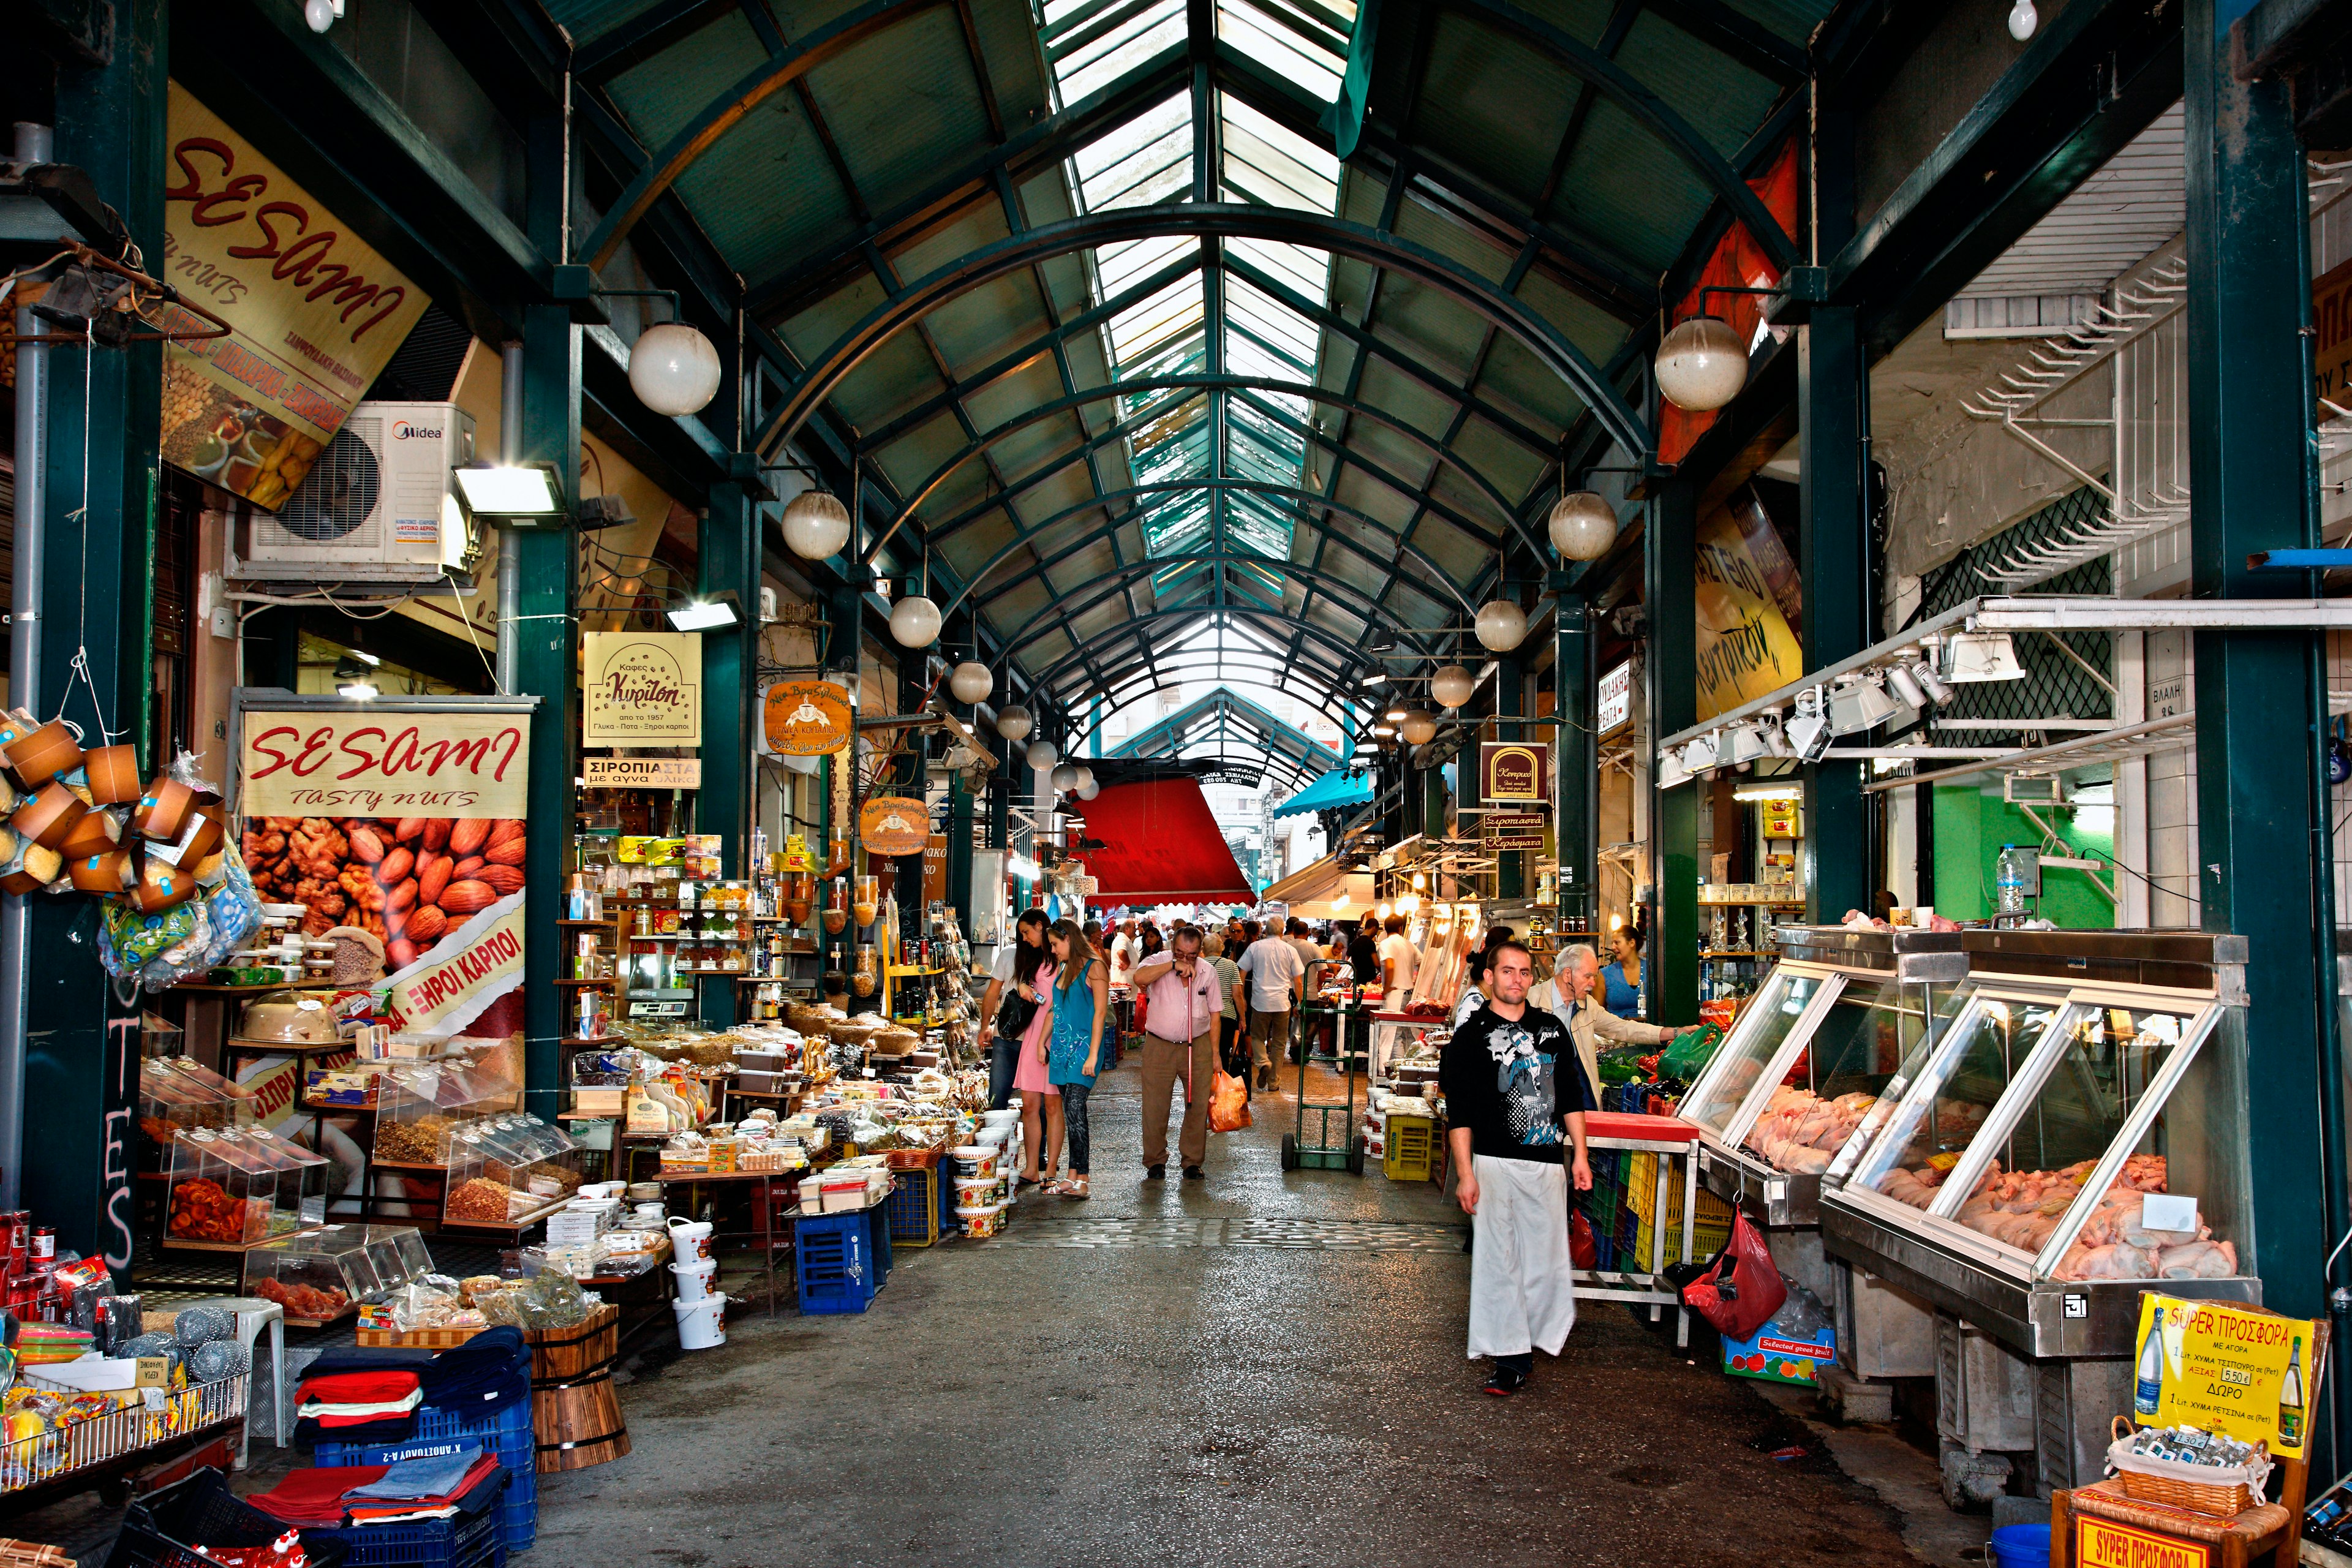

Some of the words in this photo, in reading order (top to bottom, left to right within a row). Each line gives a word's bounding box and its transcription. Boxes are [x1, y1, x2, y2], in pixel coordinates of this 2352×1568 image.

[165, 137, 405, 344] SESAMI
[399, 427, 442, 439] Midea
[620, 664, 647, 673] Καφες
[1599, 670, 1628, 706] ΟΥΔΑΚΗΣ
[2154, 684, 2180, 703] ΒΛΑΛΗ
[1599, 705, 1617, 730] ΡΕΑΤΑ
[249, 726, 521, 782] SESAMI
[590, 763, 696, 774] ΣΙΡΟΠΙΑΣΤΑ
[1486, 815, 1542, 827] Σιροπιαστά
[1487, 837, 1542, 850] Κεράσματα
[407, 964, 466, 1016] ΞΗΡΟΙ
[456, 927, 522, 984] ΚΑΡΠΟΙ
[2169, 1307, 2214, 1335] SUPER
[2219, 1314, 2288, 1348] ΠΡΟΣΦΟΡΑ
[1762, 1339, 1794, 1351] Selected
[1795, 1346, 1814, 1355] greek
[1814, 1347, 1830, 1356] fruit
[2225, 1344, 2248, 1354] ΑΓΟΡΑ
[2173, 1346, 2179, 1357] 1
[2180, 1351, 2192, 1360] Lit.
[2193, 1354, 2215, 1365] ΧΥΜΑ
[2217, 1358, 2255, 1372] ΤΣΙΠΟΥΡΟ
[2264, 1366, 2278, 1377] (Pet)
[2188, 1366, 2215, 1378] ΑΞΙΑΣ
[2225, 1370, 2243, 1383] 5.50
[2243, 1375, 2249, 1384] €
[2206, 1382, 2242, 1400] ΔΩΡΟ
[2169, 1393, 2175, 1404] 1
[2177, 1398, 2188, 1408] Lit.
[2190, 1401, 2211, 1411] ΧΥΜΑ
[2212, 1406, 2245, 1419] ΡΕΤΣΙΝΑ
[2255, 1413, 2271, 1425] (Pet)
[2177, 1434, 2196, 1446] 1.30
[2197, 1439, 2204, 1448] €
